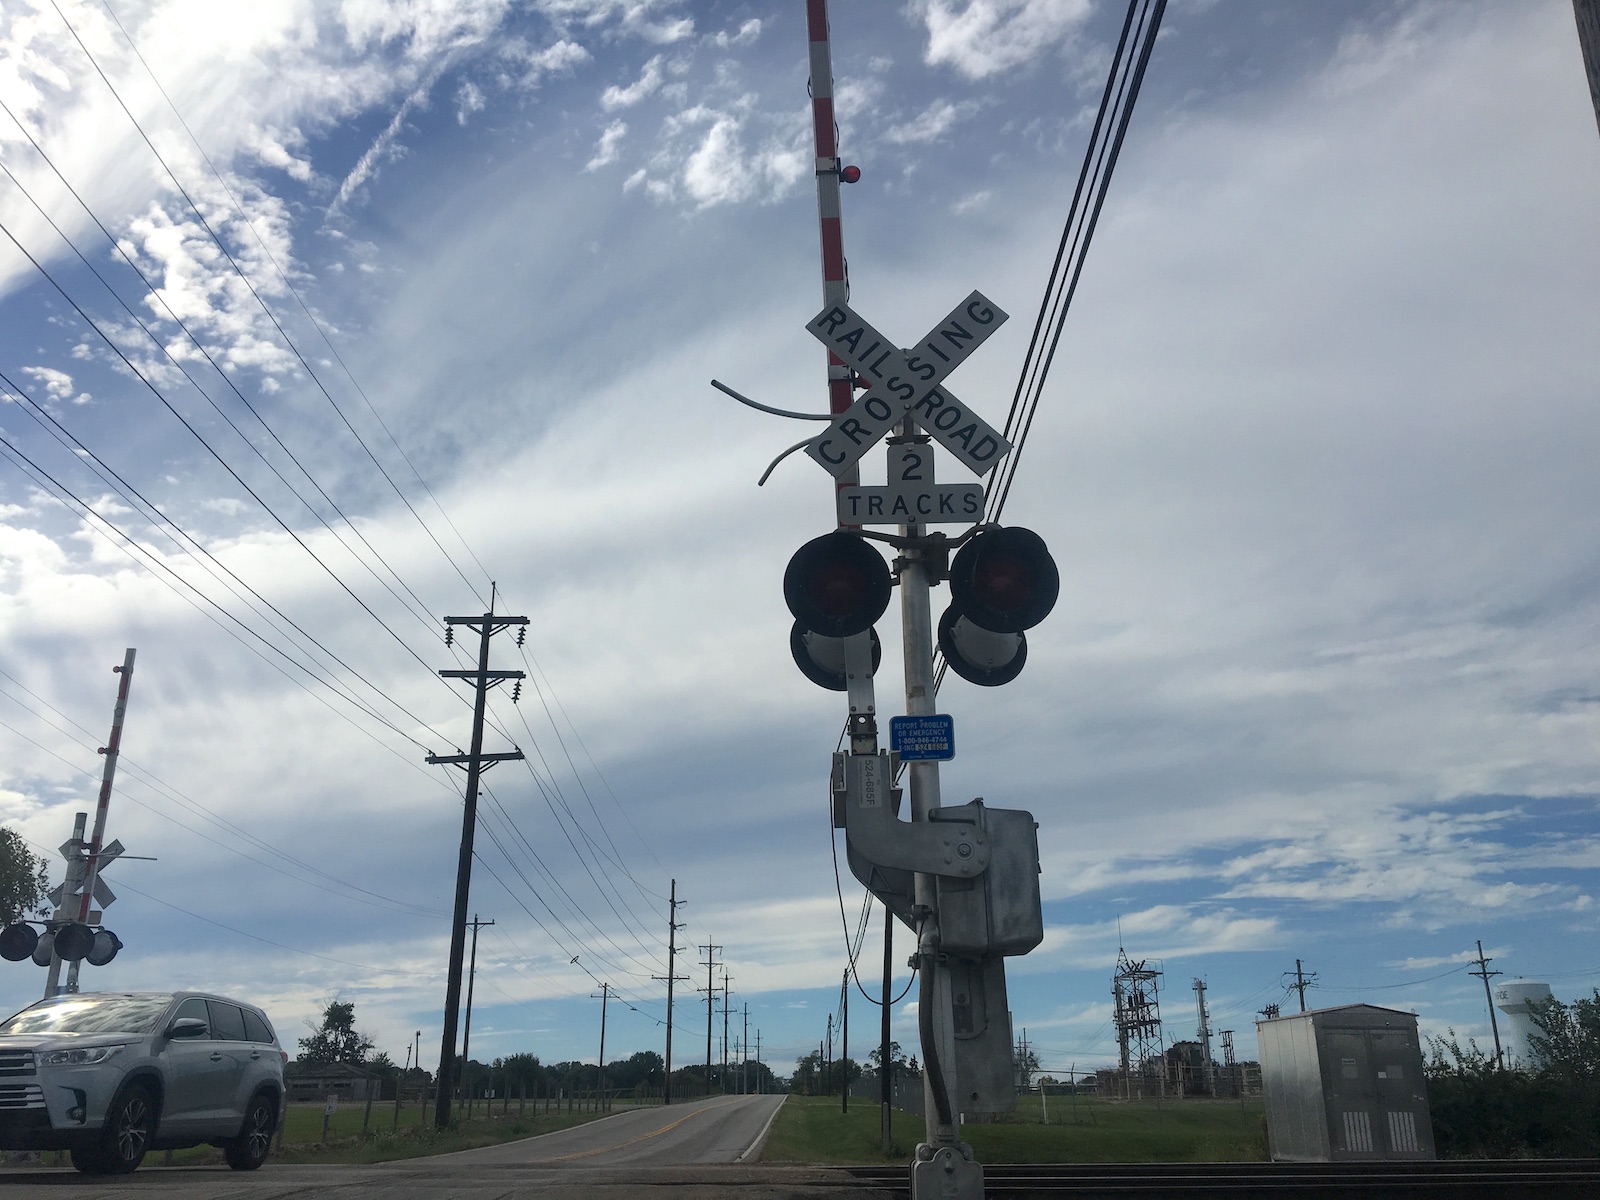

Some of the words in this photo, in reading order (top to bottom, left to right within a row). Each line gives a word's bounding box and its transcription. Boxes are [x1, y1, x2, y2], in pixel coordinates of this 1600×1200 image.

[817, 306, 892, 378] RAIL
[915, 388, 998, 462] ROAD
[818, 301, 994, 464] CROSSING
[901, 453, 922, 481] 2
[847, 493, 978, 516] TRACKS
[894, 722, 918, 730] REPORT
[920, 721, 948, 729] PROBLEM
[909, 729, 946, 737] EMERGENCY
[865, 759, 875, 806] 524-685F
